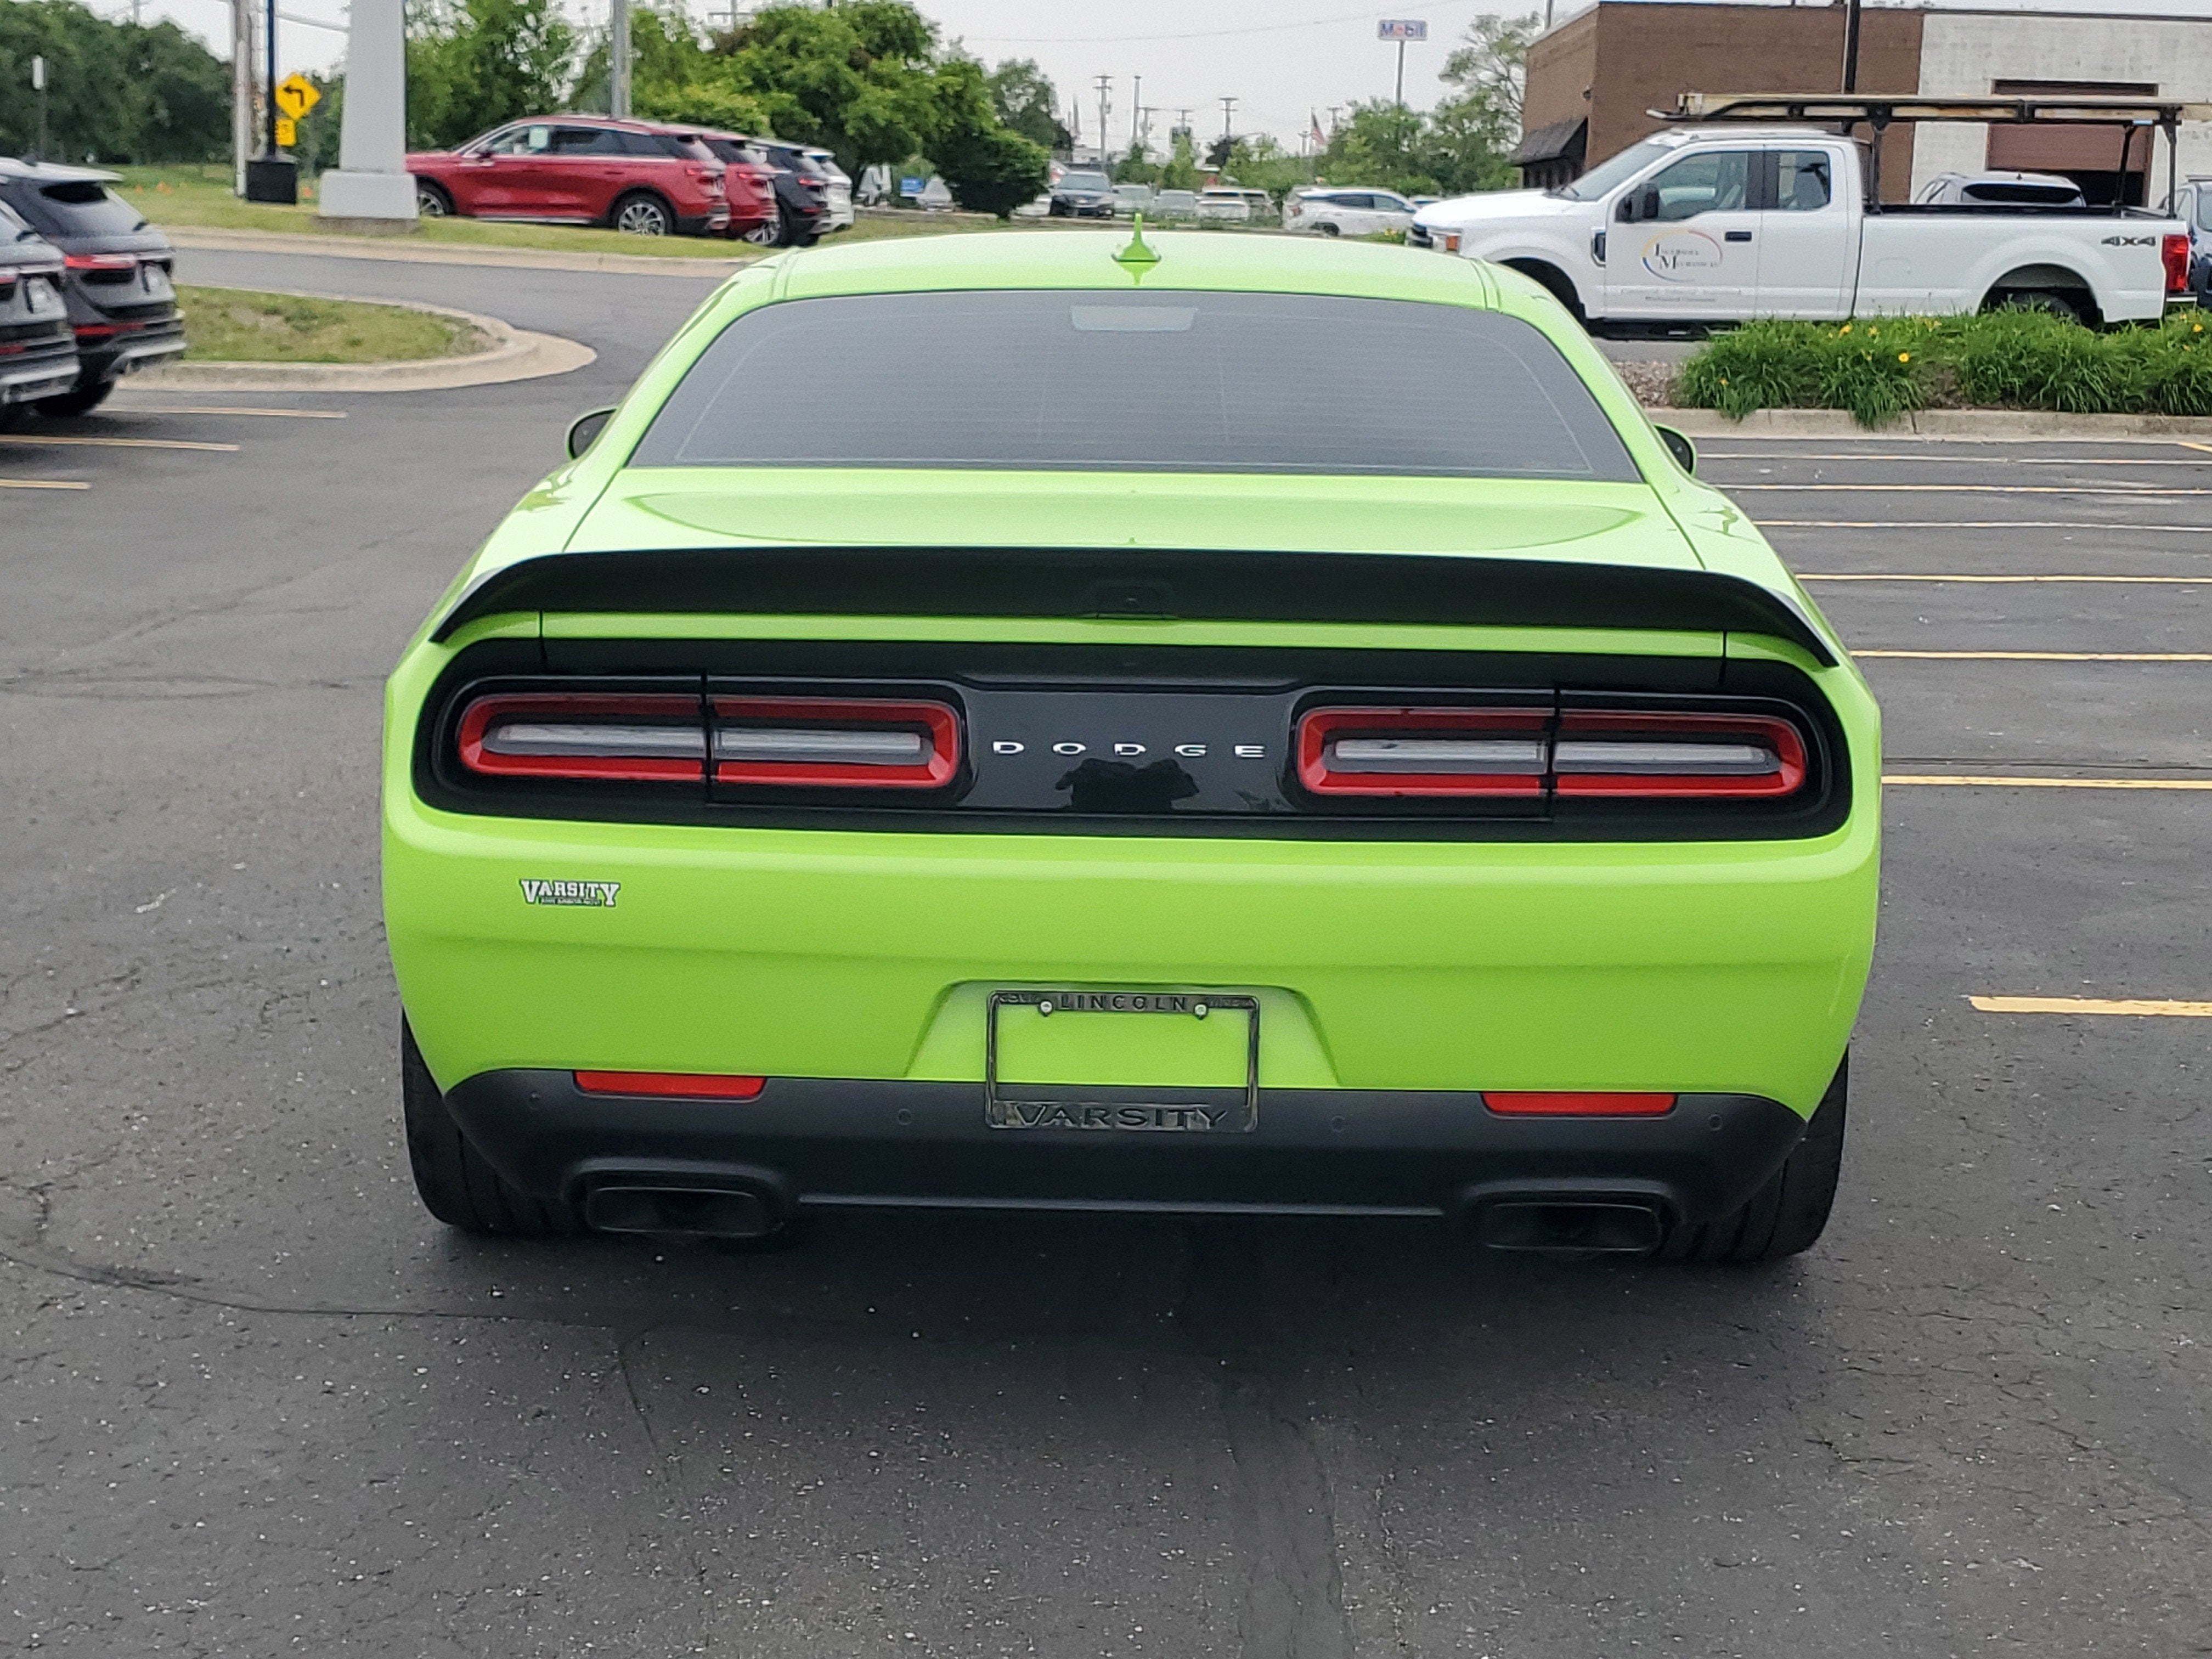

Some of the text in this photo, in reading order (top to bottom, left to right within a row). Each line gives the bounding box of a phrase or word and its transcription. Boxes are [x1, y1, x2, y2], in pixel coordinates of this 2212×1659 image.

[1381, 23, 1424, 37] Mobil
[992, 741, 1266, 758] DODGE
[520, 879, 620, 906] VARSITY
[1060, 995, 1187, 1011] LINCOLN
[1016, 1105, 1228, 1128] VARSITY
